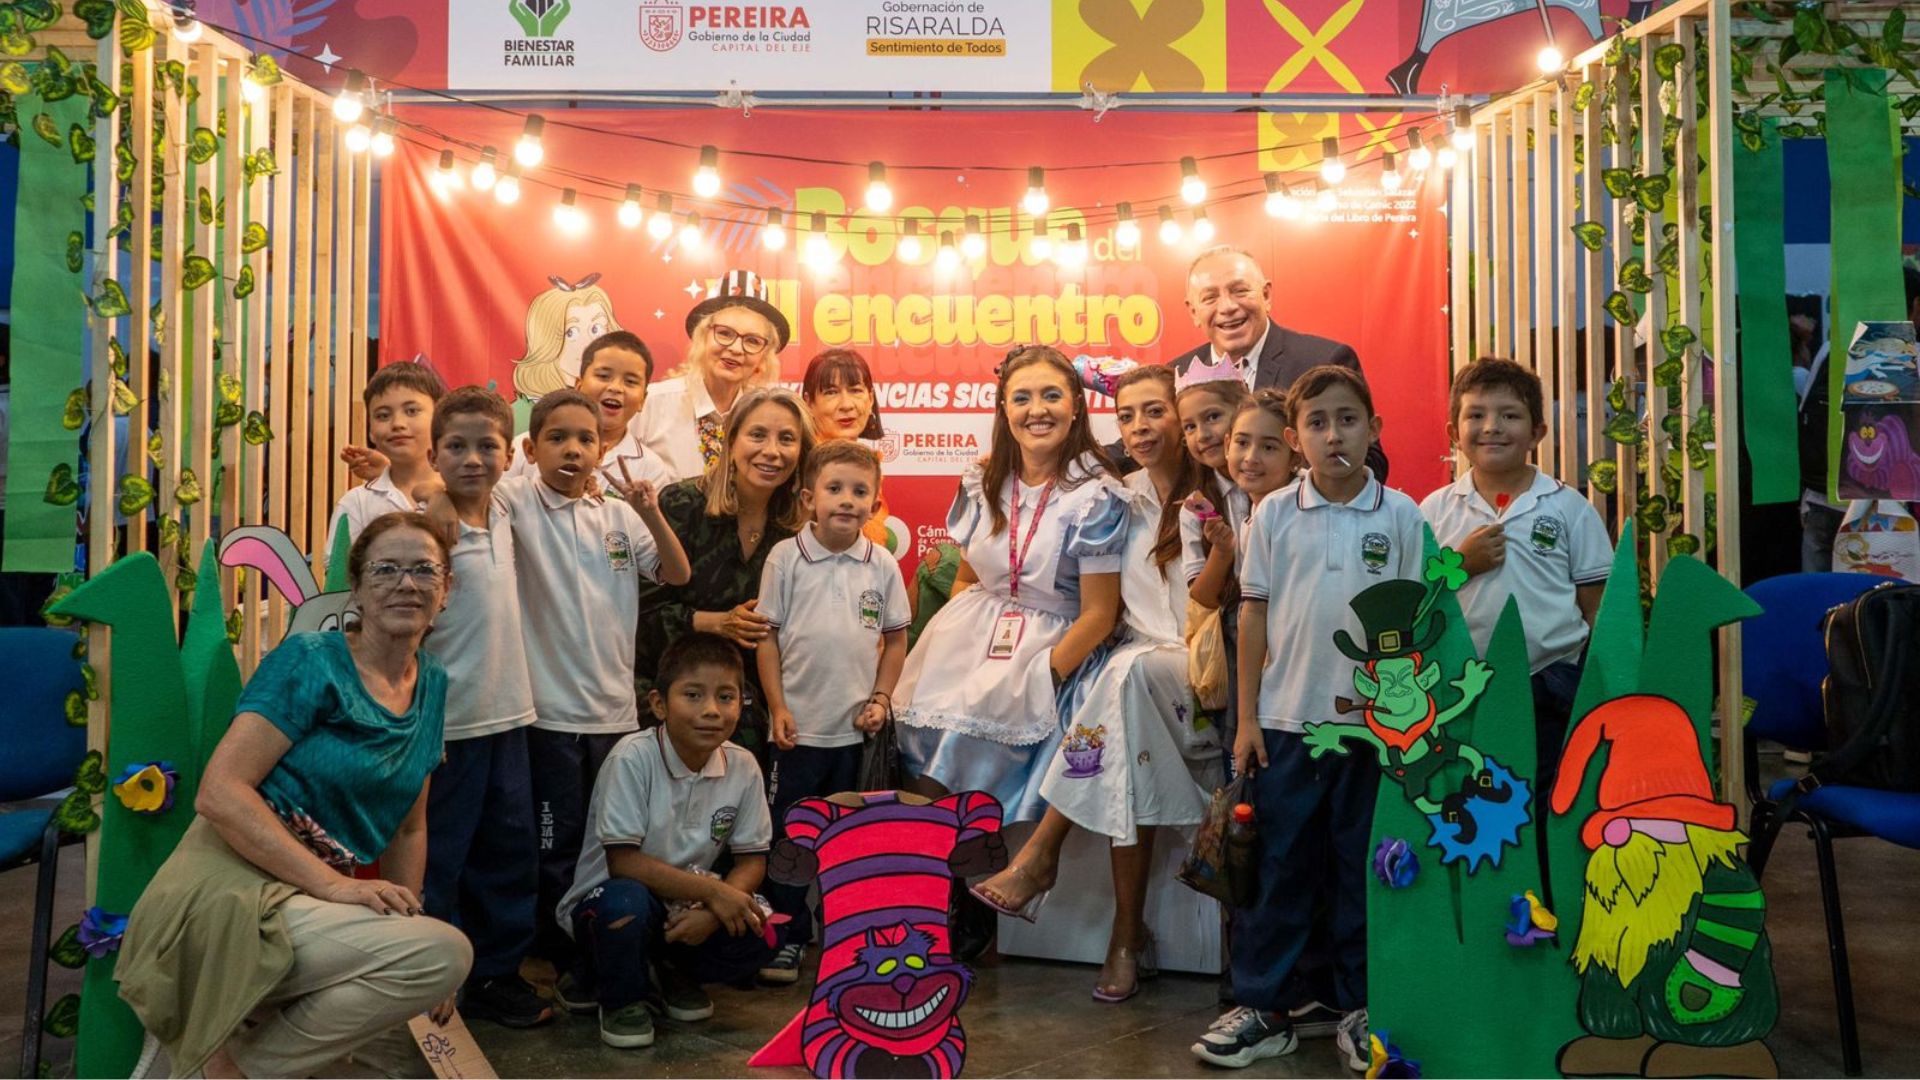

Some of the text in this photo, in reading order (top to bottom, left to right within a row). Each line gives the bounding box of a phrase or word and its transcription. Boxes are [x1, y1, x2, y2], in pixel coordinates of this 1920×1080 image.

[882, 1, 984, 13] Gobernación de
[689, 6, 810, 28] PEREIRA
[866, 16, 1005, 35] RISARALDA
[688, 31, 739, 42] Gobierno
[742, 31, 756, 42] de
[759, 31, 769, 42] la
[772, 31, 811, 42] Ciudad
[504, 40, 575, 52] BIENESTAR
[712, 43, 811, 52] CAPITAL DEL EJE
[870, 42, 1001, 53] Sentimiento de Todos
[504, 54, 575, 66] FAMILIAR
[795, 187, 1142, 280] Bosque del
[813, 282, 1160, 345] encuentro
[903, 433, 978, 448] PEREIRA
[917, 525, 948, 538] Cám
